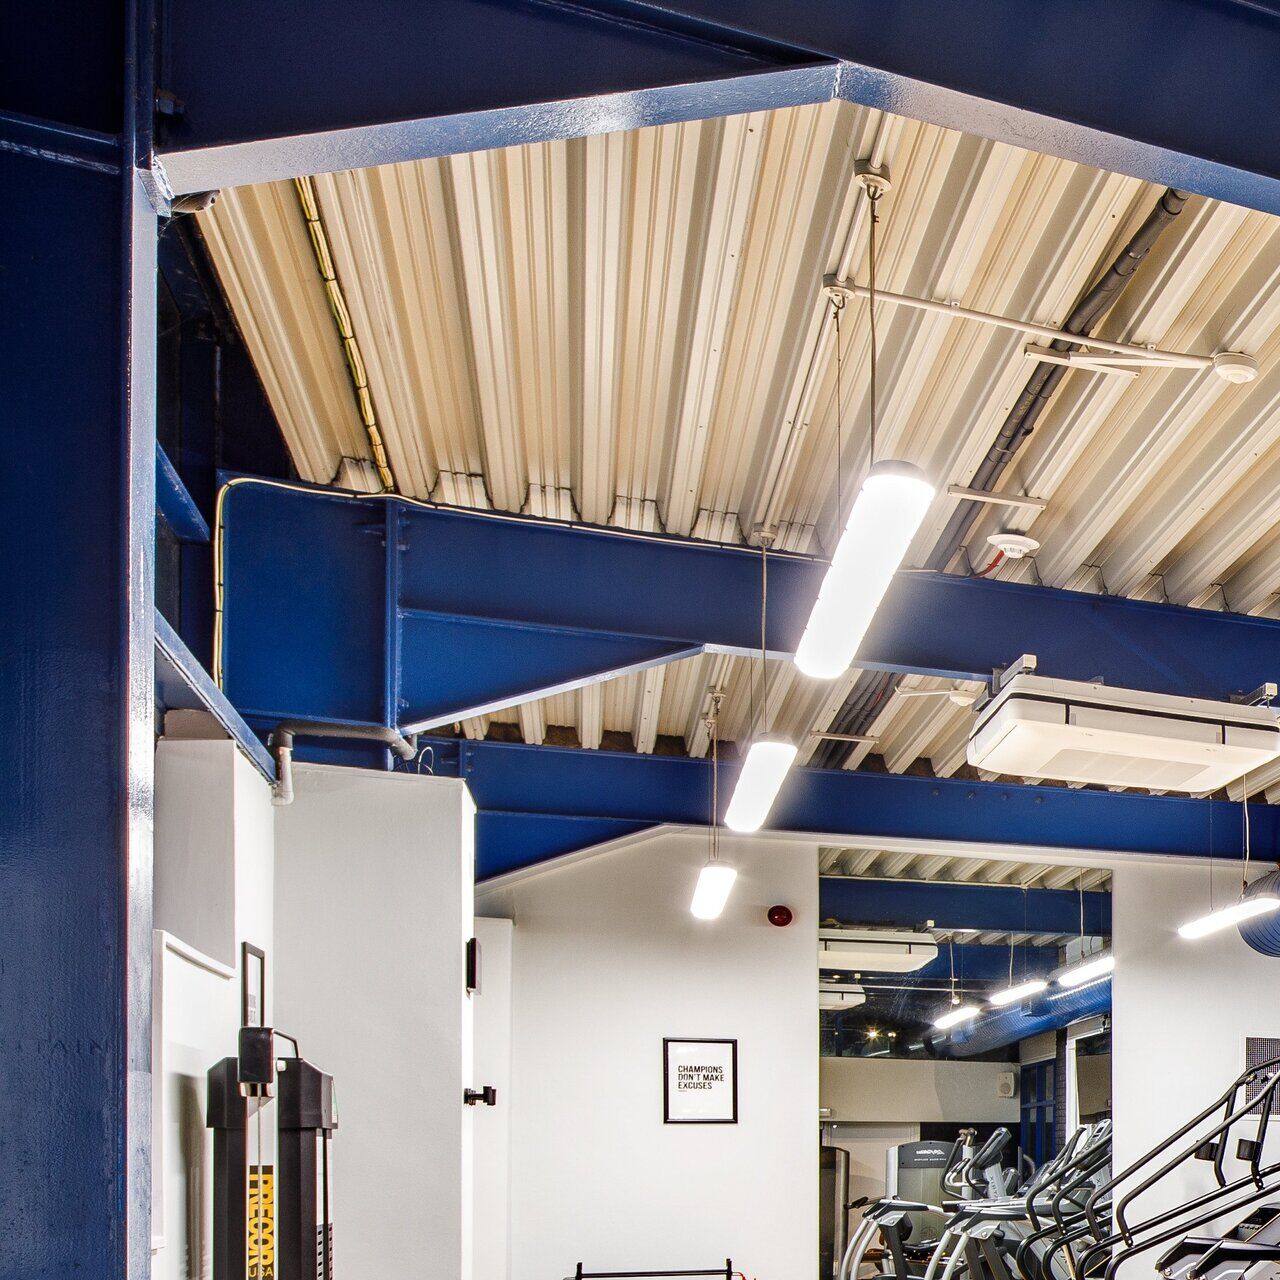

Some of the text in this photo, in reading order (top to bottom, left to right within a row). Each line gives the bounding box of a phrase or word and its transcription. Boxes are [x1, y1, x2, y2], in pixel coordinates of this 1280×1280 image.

[678, 1065, 723, 1073] CHAMPIONS
[249, 1174, 274, 1266] PRECOR
[249, 1267, 273, 1277] USA
